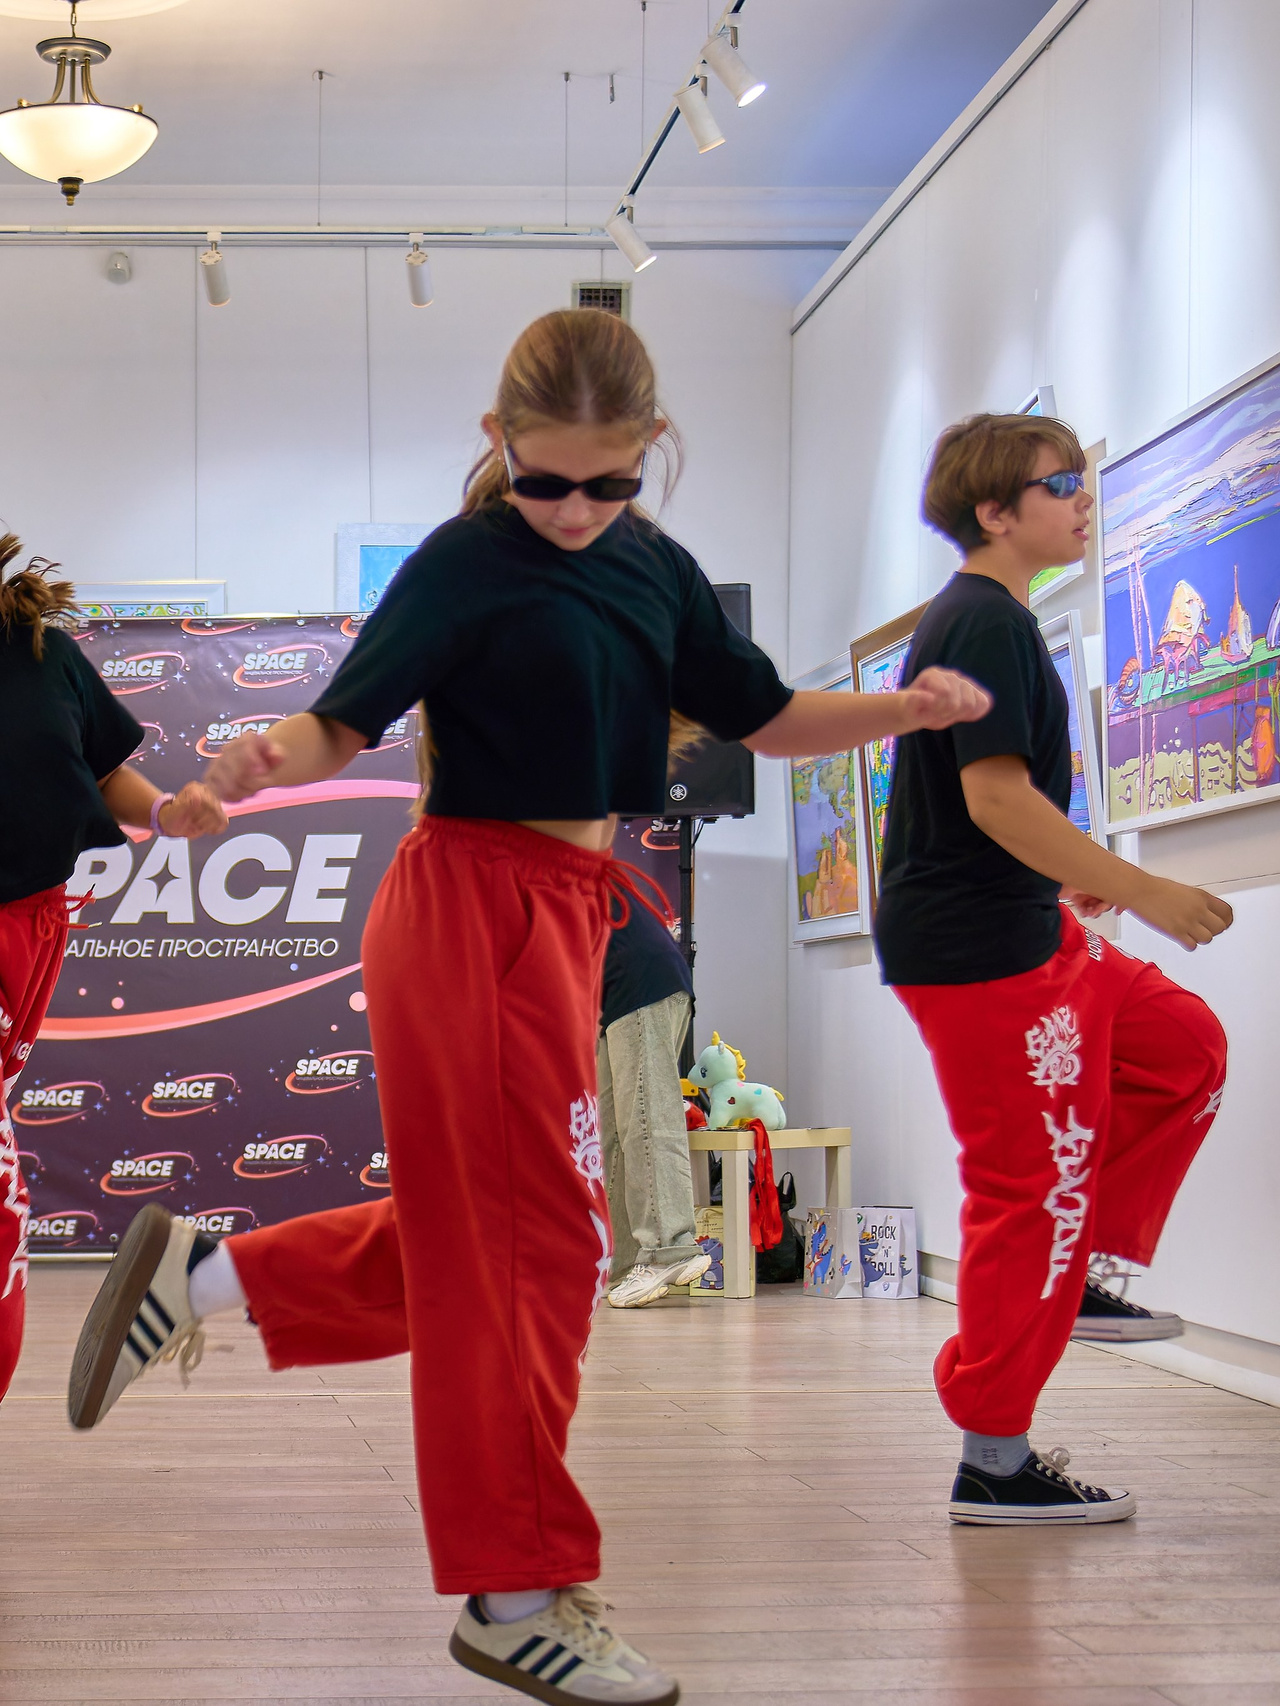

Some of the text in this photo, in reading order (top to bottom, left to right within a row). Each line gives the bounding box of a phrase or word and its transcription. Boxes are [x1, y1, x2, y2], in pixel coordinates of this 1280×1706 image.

[101, 660, 165, 677] SPACE
[242, 652, 308, 670] SPACE
[66, 833, 363, 926] PACE
[64, 938, 340, 958] АЛЬНОЕ ПРОСТРАНСТВО
[295, 1059, 359, 1075] SPACE
[21, 1089, 84, 1106] SPACE
[152, 1081, 216, 1098] SPACE
[243, 1143, 307, 1159] SPACE
[110, 1160, 174, 1177] SPACE
[27, 1219, 77, 1236] PACE
[871, 1225, 897, 1241] ROCK
